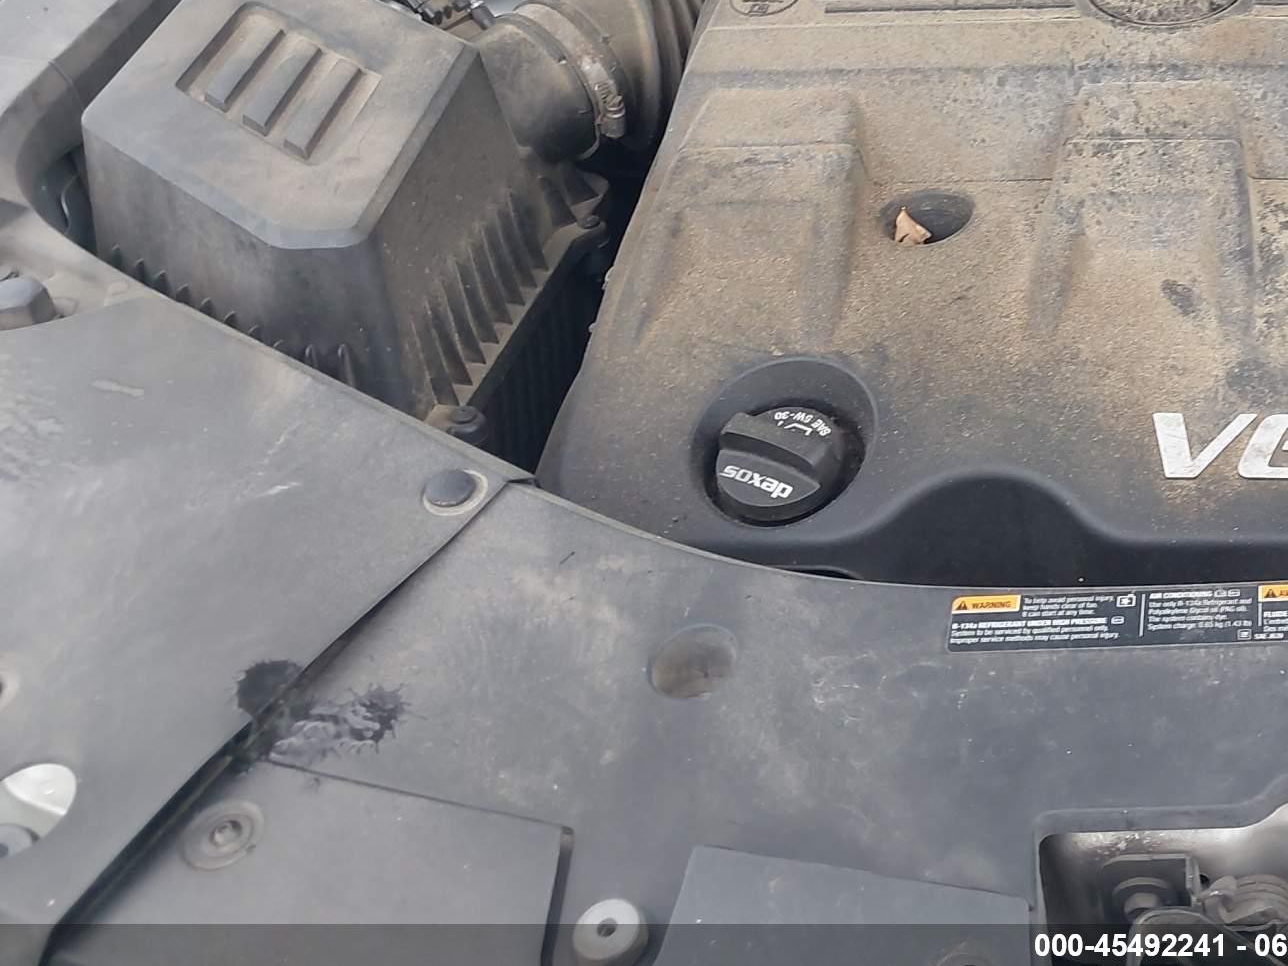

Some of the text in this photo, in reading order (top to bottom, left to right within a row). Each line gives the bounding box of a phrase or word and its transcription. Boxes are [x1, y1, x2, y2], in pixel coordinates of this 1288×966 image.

[774, 411, 813, 423] 5W-30
[719, 465, 794, 499] dexos
[971, 600, 1011, 609] WARNING
[1070, 617, 1108, 625] PRESSURE
